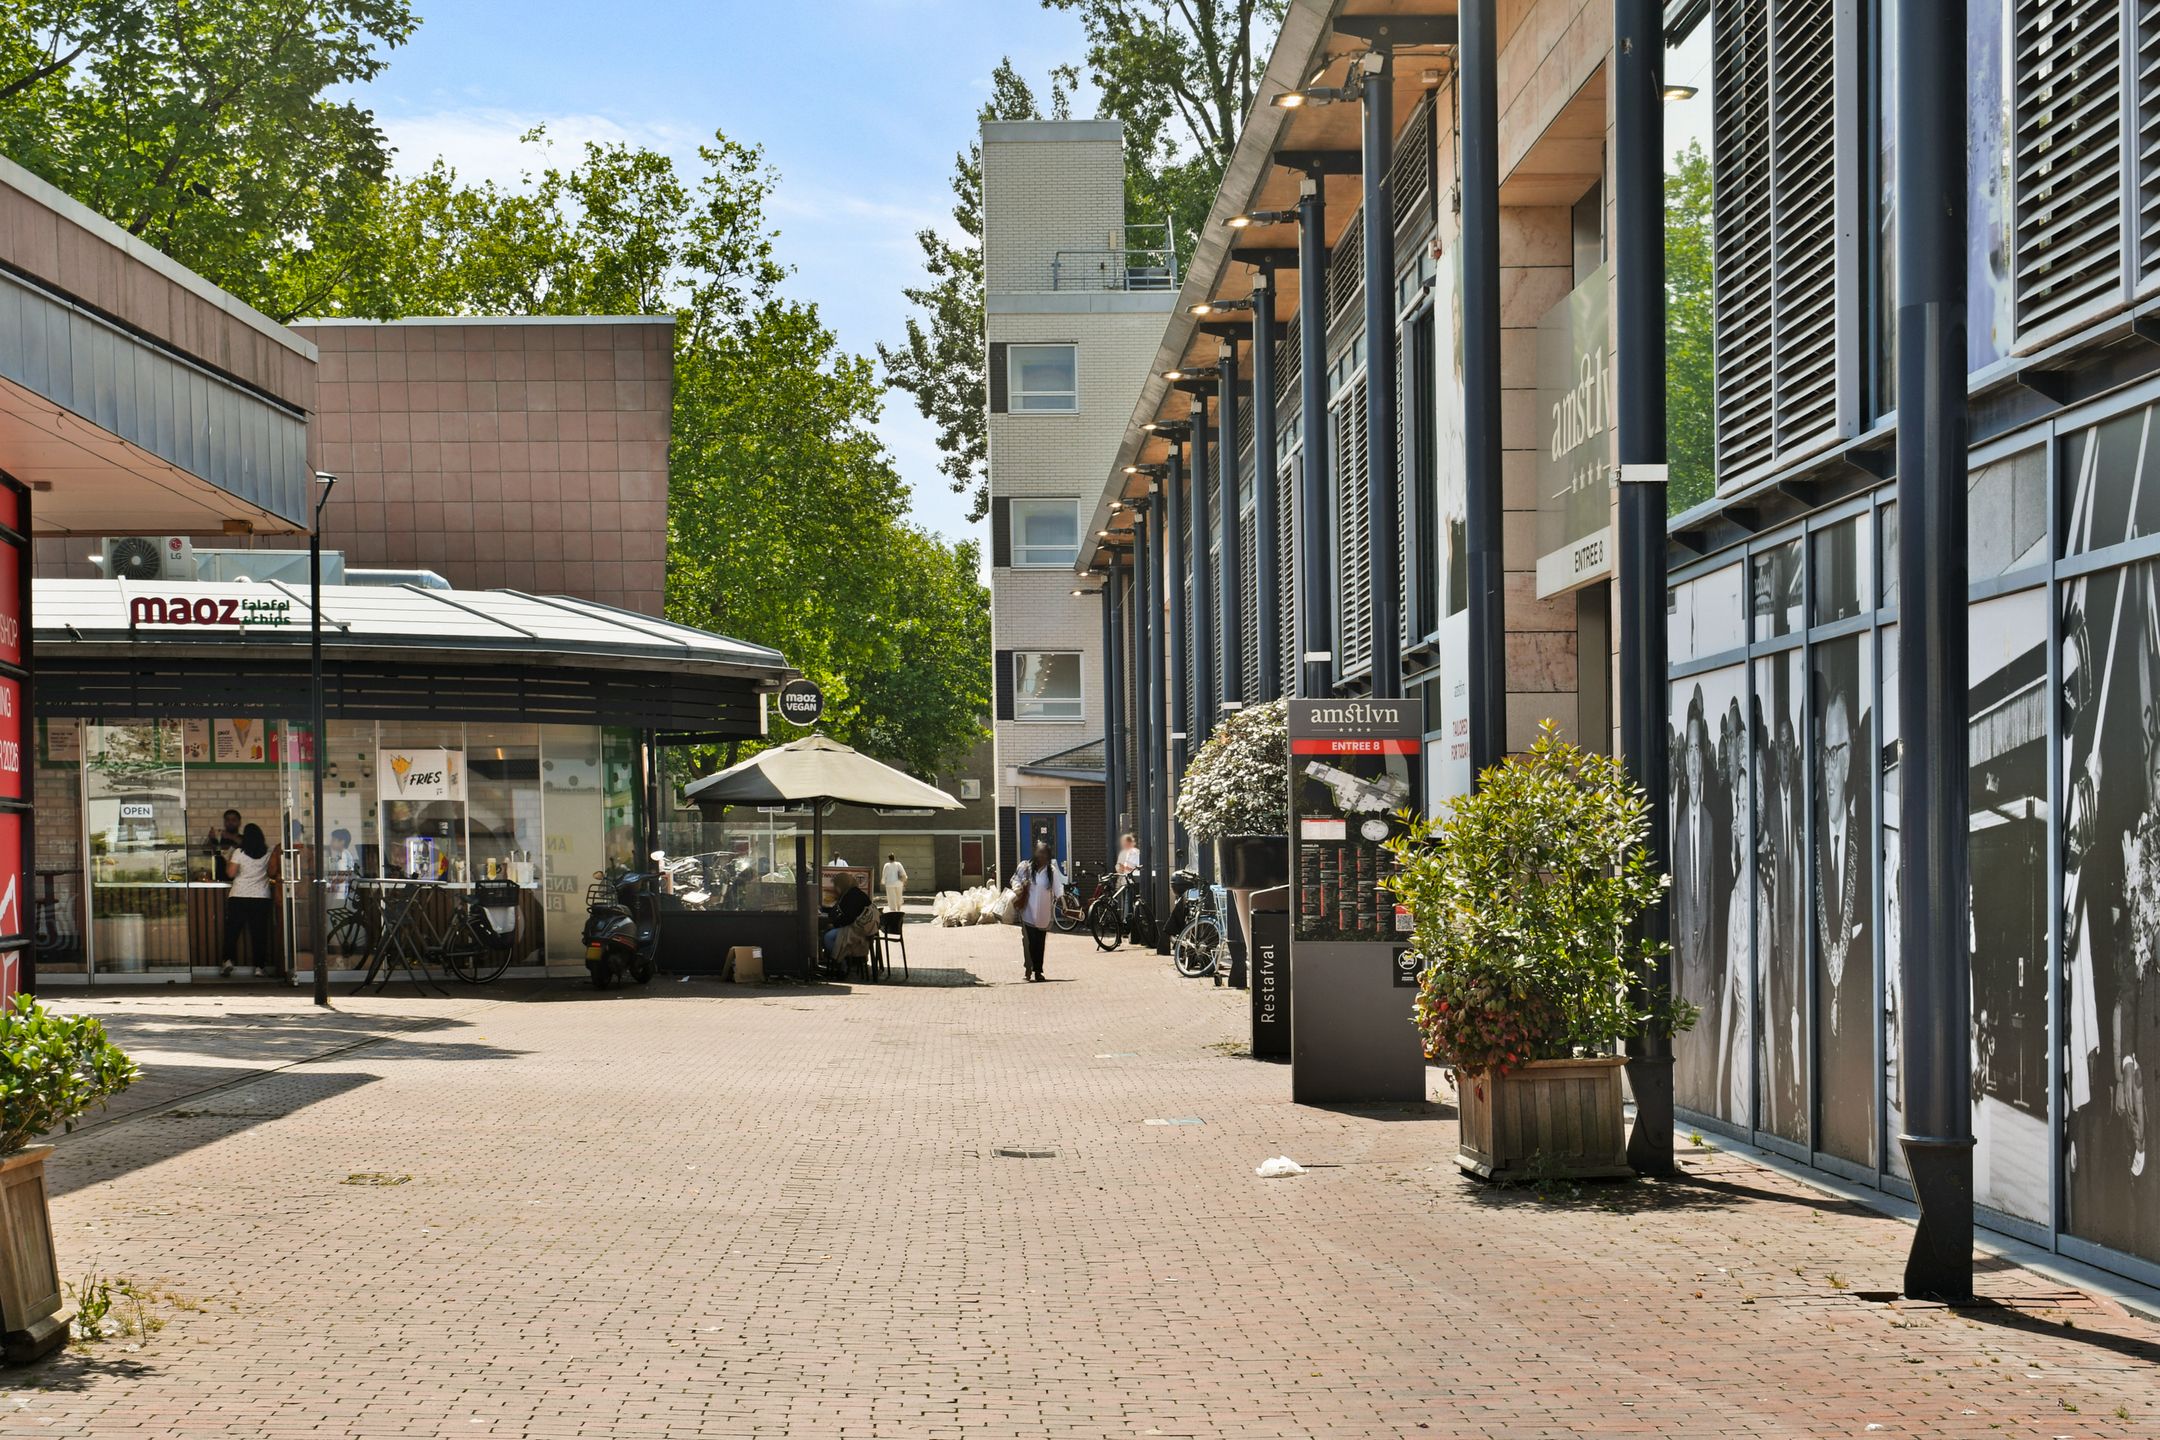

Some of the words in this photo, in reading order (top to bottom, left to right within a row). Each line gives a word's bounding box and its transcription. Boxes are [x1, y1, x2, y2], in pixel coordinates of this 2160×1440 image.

[170, 552, 182, 560] LG
[1574, 544, 1598, 574] ENTREE
[130, 596, 241, 625] maoz
[241, 598, 290, 611] falafel
[241, 612, 291, 628] &chips
[785, 693, 817, 703] maoz
[785, 702, 817, 712] VEGAN
[1310, 703, 1400, 724] amstlvn
[1331, 741, 1371, 751] ENTREE
[1373, 741, 1381, 751] 8
[3, 740, 19, 772] 2026
[409, 770, 442, 786] FRIES
[122, 805, 151, 816] OPEN
[1259, 944, 1275, 1023] Restafval
